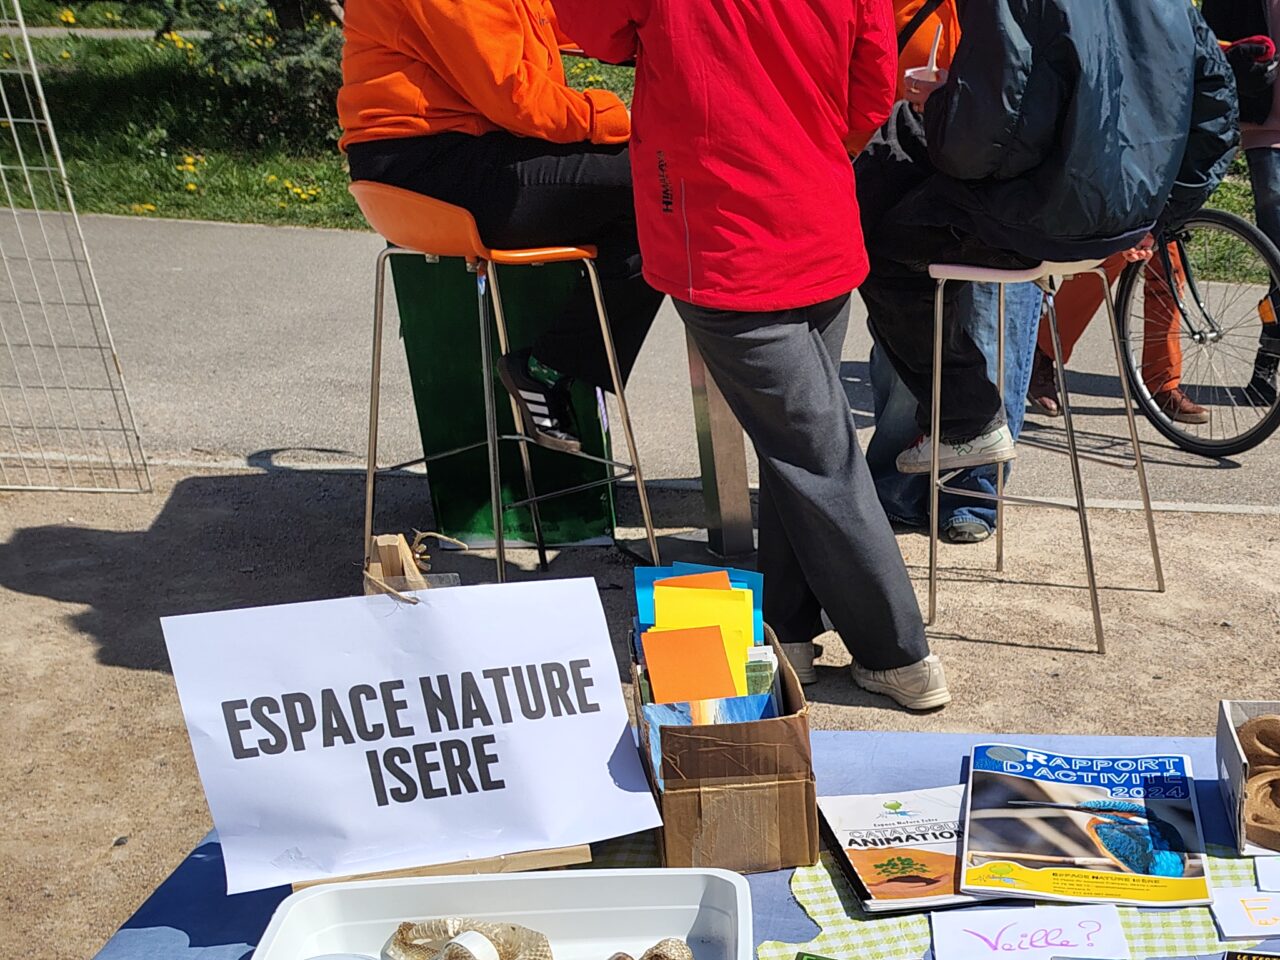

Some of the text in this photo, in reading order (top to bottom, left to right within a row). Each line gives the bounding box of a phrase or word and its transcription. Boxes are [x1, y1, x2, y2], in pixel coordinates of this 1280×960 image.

[221, 658, 601, 760] ESPACE NATURE
[366, 734, 506, 807] ISERE
[1003, 760, 1183, 784] D'ACTIVITÉ
[1026, 751, 1179, 772] RAPPORT
[1111, 785, 1185, 799] 2024
[848, 821, 960, 838] CATALOGU
